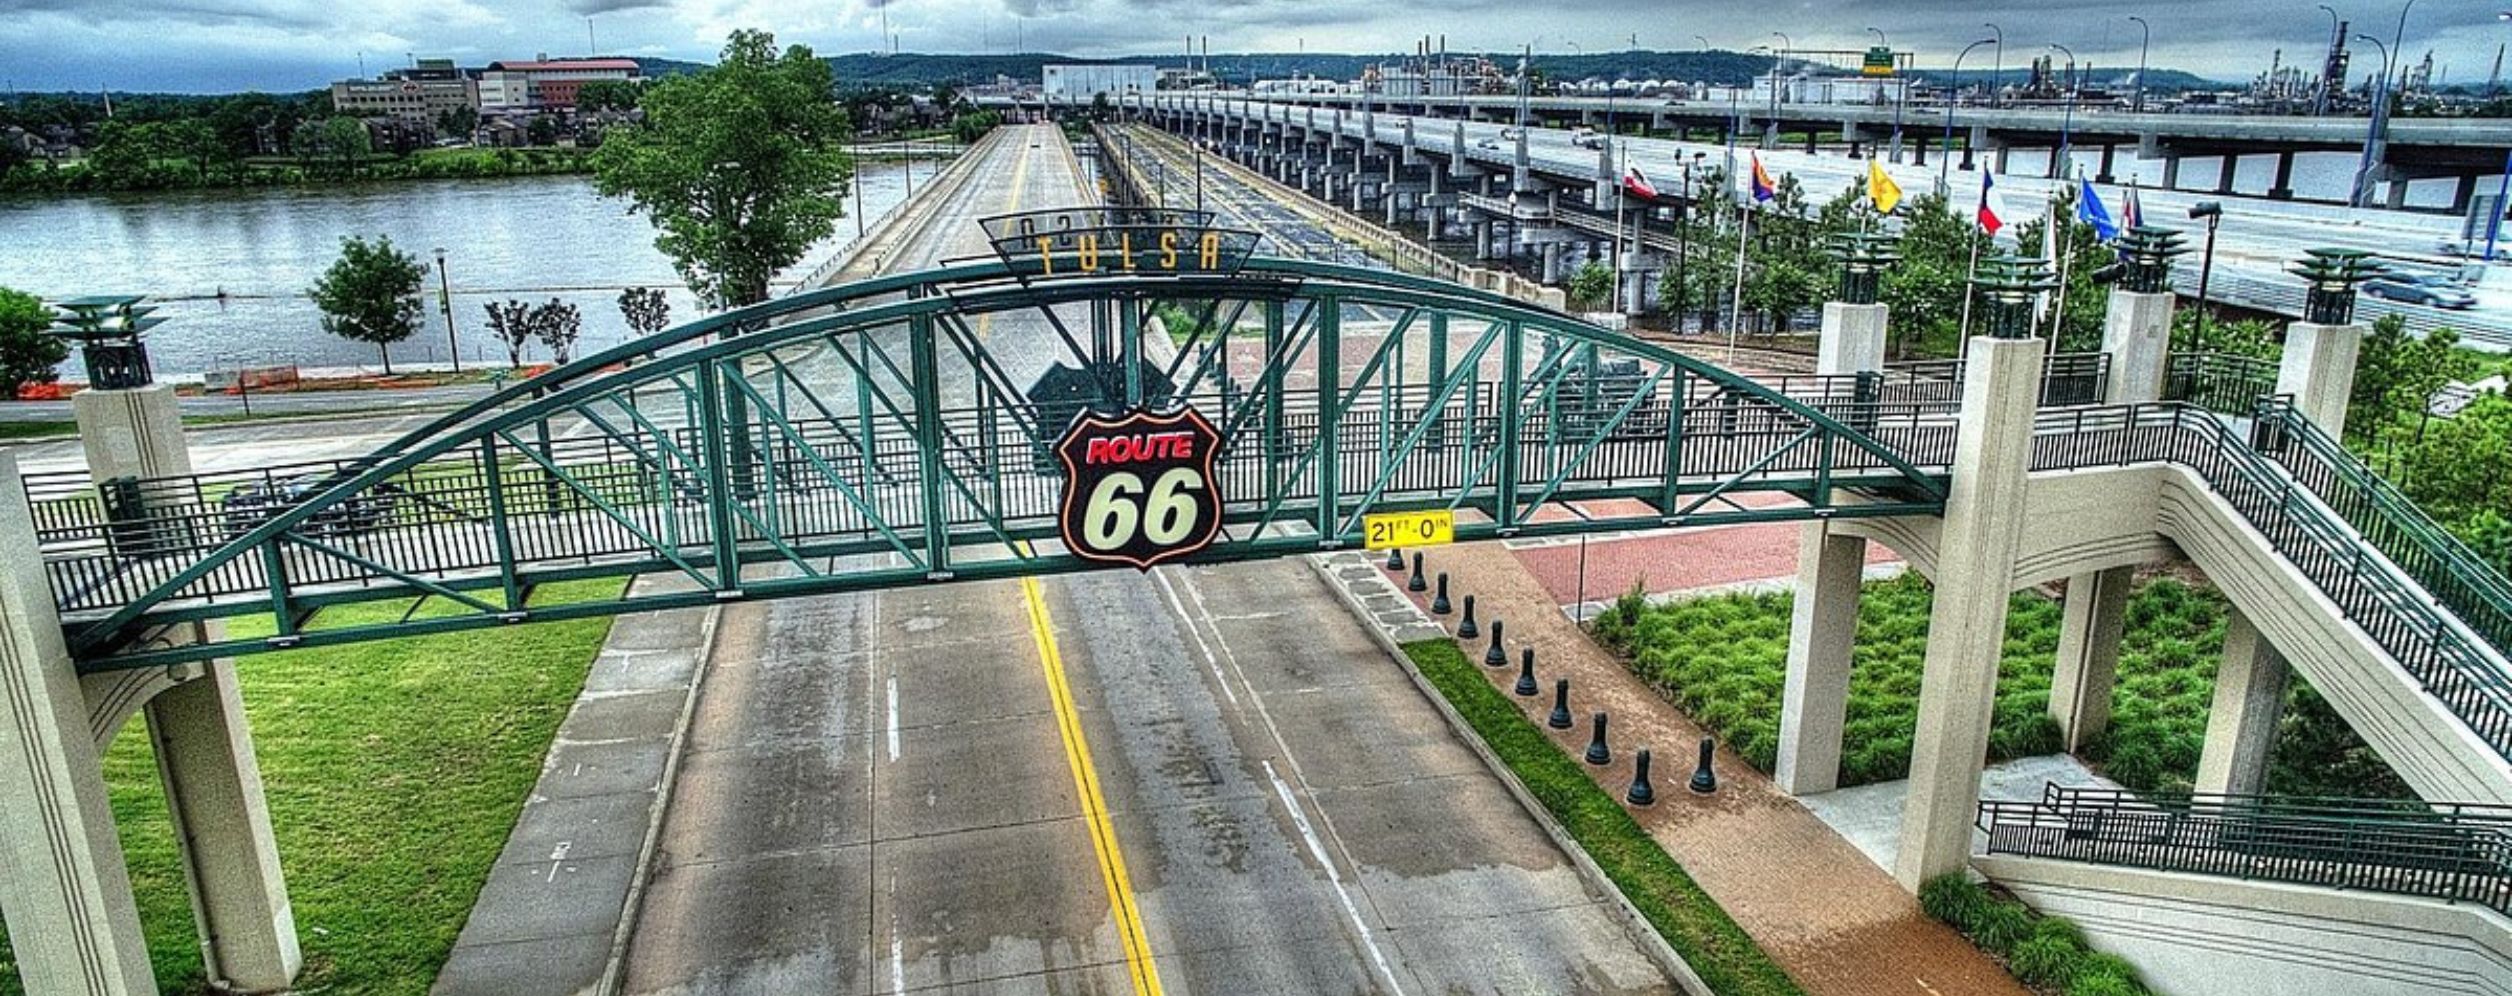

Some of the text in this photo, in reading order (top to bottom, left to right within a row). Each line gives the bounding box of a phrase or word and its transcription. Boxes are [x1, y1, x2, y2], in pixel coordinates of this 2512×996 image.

[1037, 231, 1220, 275] TULSA
[1086, 431, 1195, 464] ROUTE
[1083, 467, 1203, 551] 66
